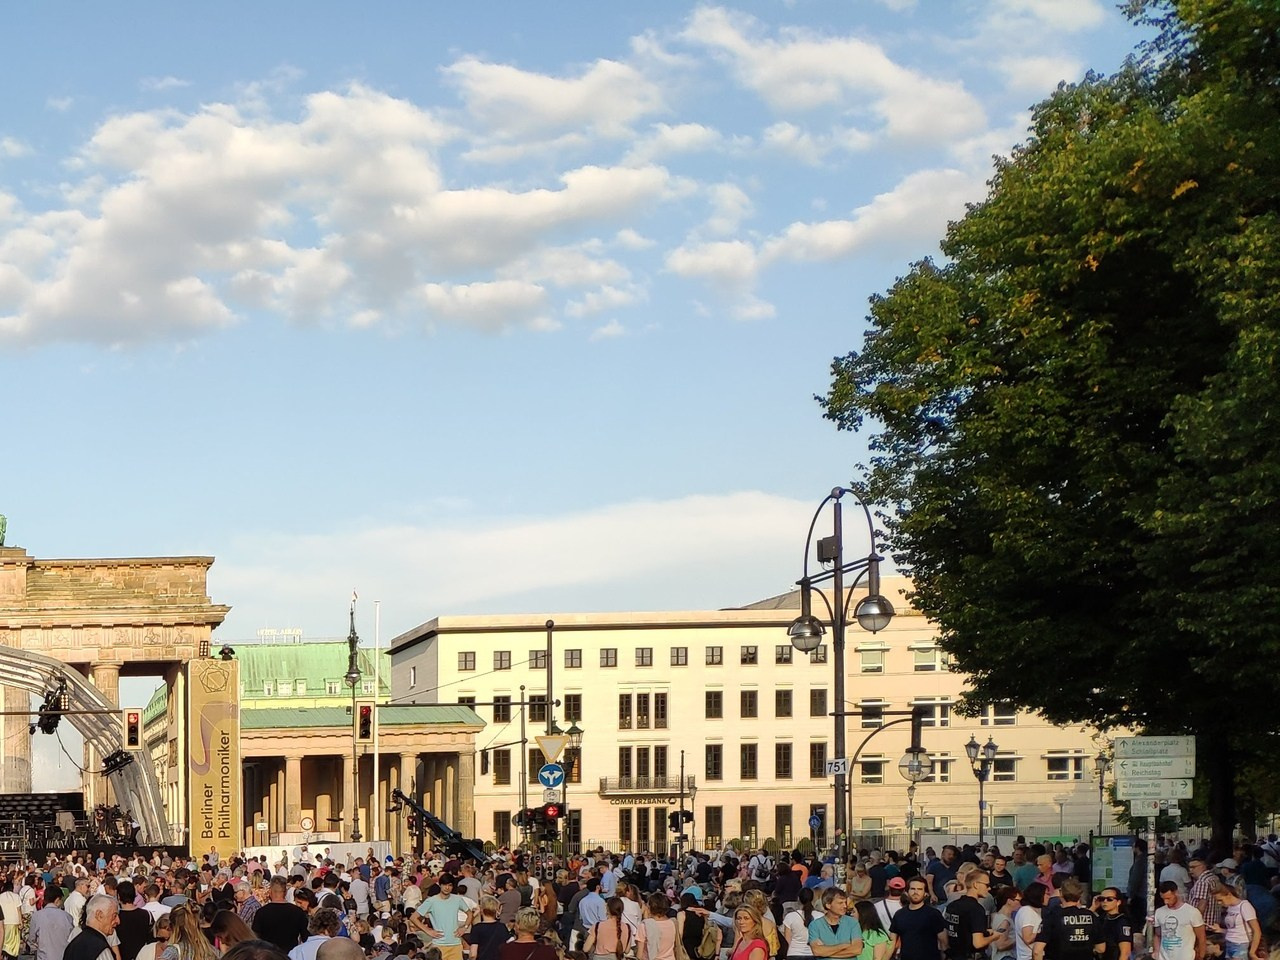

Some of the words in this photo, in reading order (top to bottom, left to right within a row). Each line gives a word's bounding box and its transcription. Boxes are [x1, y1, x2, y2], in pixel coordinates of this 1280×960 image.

[827, 760, 847, 773] 751
[217, 730, 230, 839] Philharmoniker
[609, 797, 667, 805] COMMERZBANK
[201, 783, 213, 839] Berliner
[1063, 914, 1093, 925] POLIZEI
[1069, 934, 1090, 942] 25216
